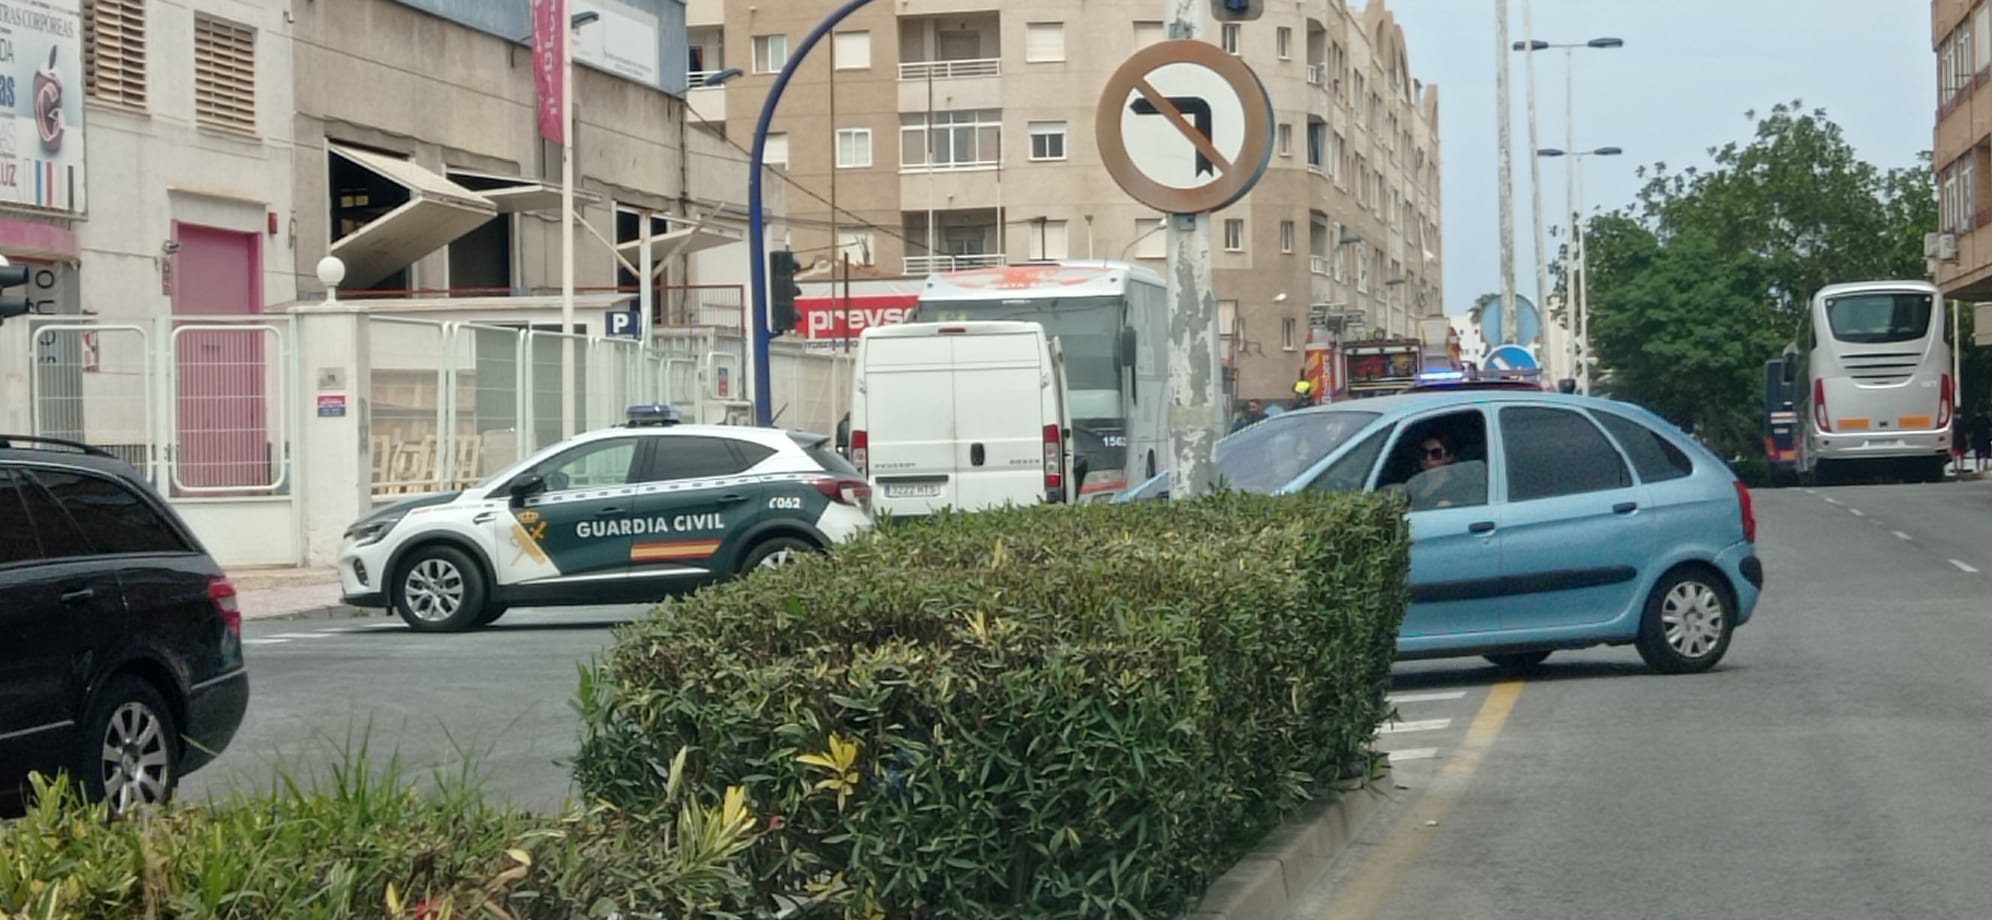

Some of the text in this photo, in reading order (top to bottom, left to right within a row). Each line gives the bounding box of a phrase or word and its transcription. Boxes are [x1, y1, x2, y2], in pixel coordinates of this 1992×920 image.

[0, 163, 17, 188] UZ
[612, 313, 629, 333] P
[776, 496, 801, 509] 062
[576, 513, 724, 538] GUARDIA CIVIL
